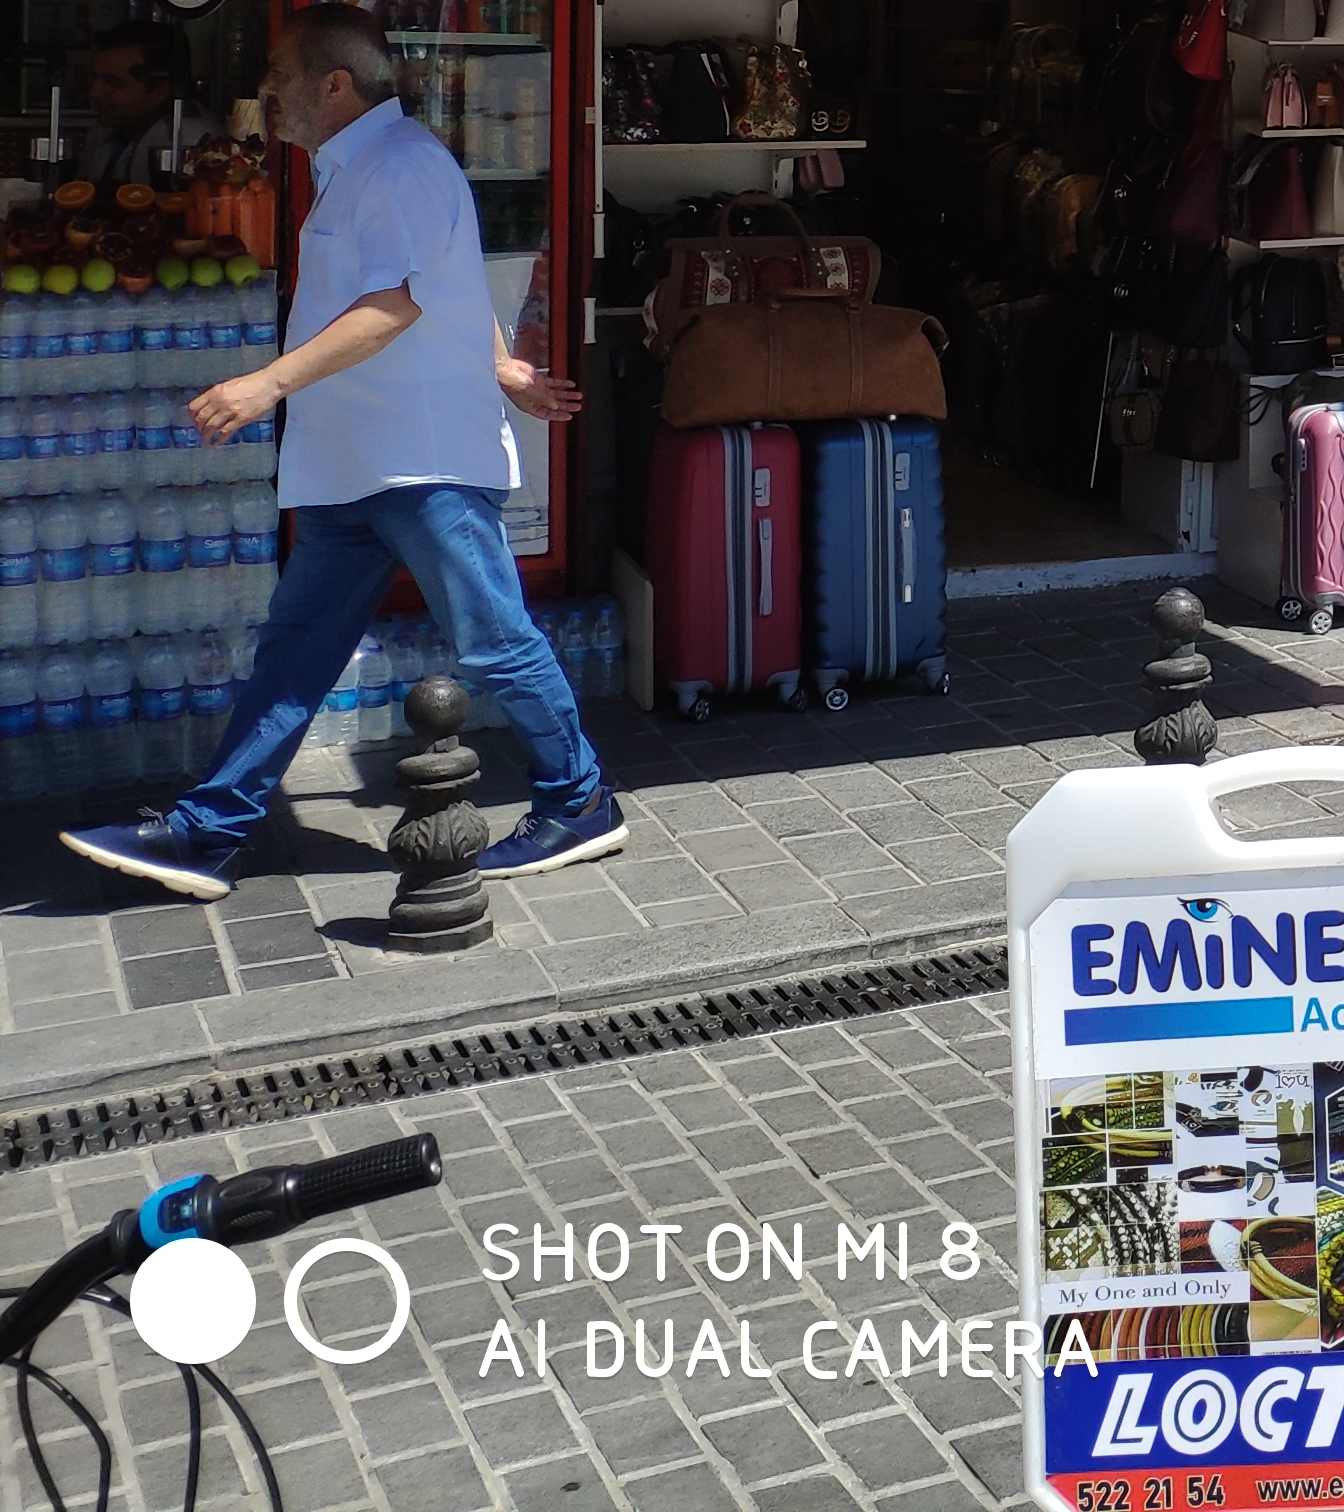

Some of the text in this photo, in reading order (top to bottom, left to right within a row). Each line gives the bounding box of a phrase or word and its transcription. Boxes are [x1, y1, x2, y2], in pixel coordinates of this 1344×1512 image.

[1059, 1279, 1232, 1308] My One and Only
[1077, 1481, 1131, 1512] 522
[1144, 1478, 1173, 1509] 21
[1187, 1475, 1226, 1507] 54
